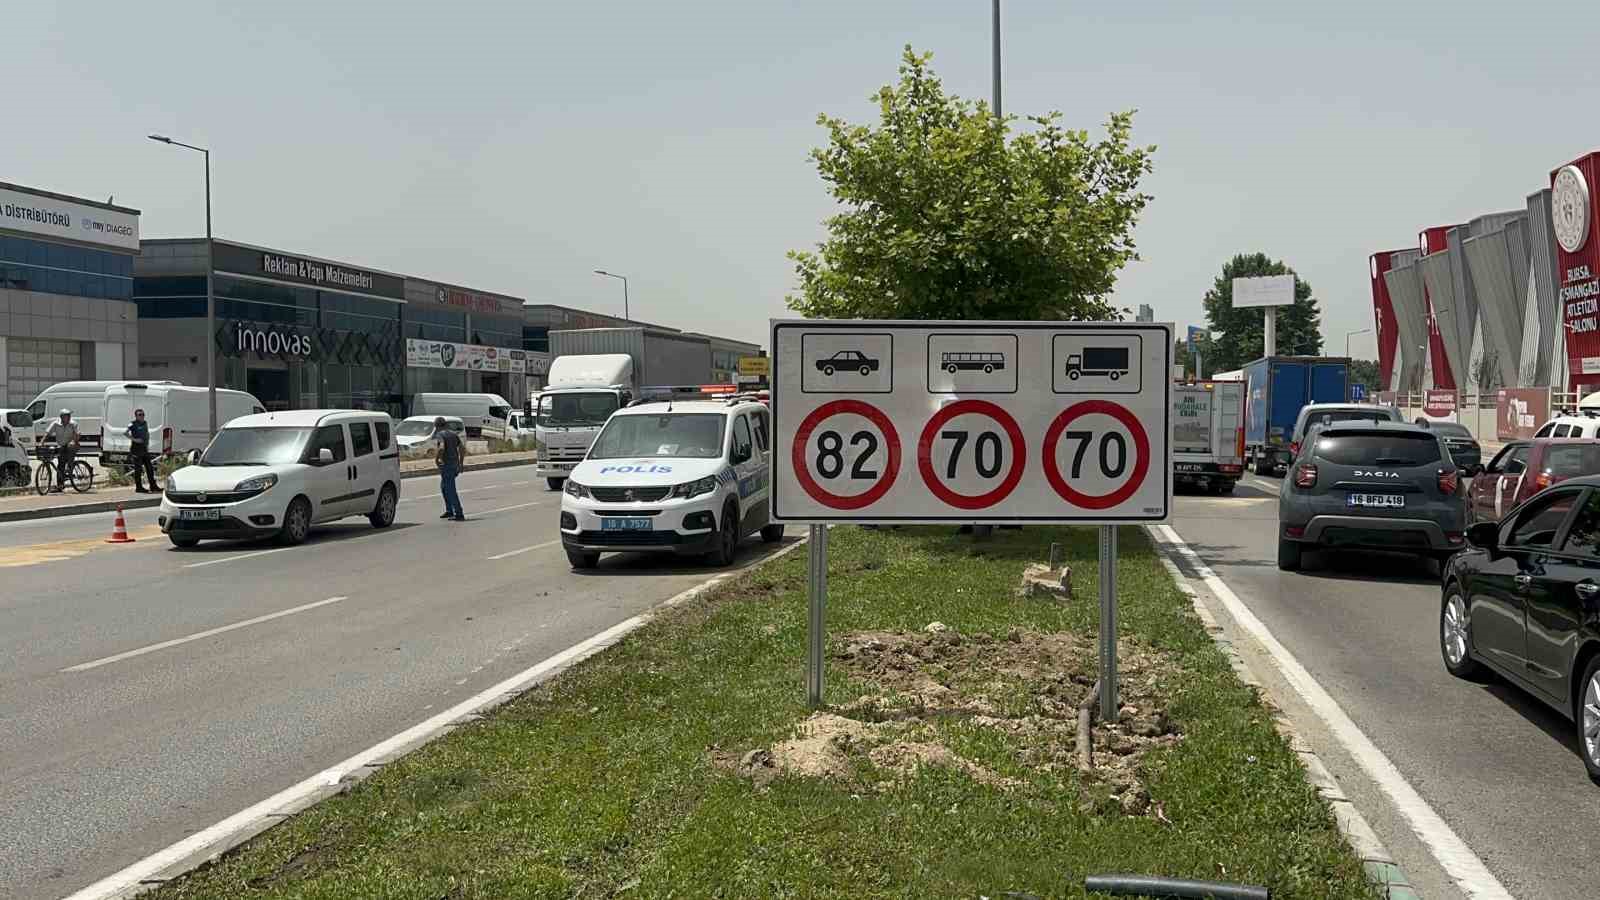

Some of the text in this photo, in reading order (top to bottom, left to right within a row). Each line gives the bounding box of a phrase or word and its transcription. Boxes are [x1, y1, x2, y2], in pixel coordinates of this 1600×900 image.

[264, 254, 298, 276] Reklam
[326, 265, 373, 288] Malzemeleri
[238, 322, 312, 355] innovas
[1570, 317, 1597, 333] SALONU
[600, 464, 673, 474] POLİS
[815, 430, 878, 480] 82
[940, 431, 1003, 479] 70
[1065, 431, 1127, 479] 70
[1353, 470, 1399, 478] DACIA
